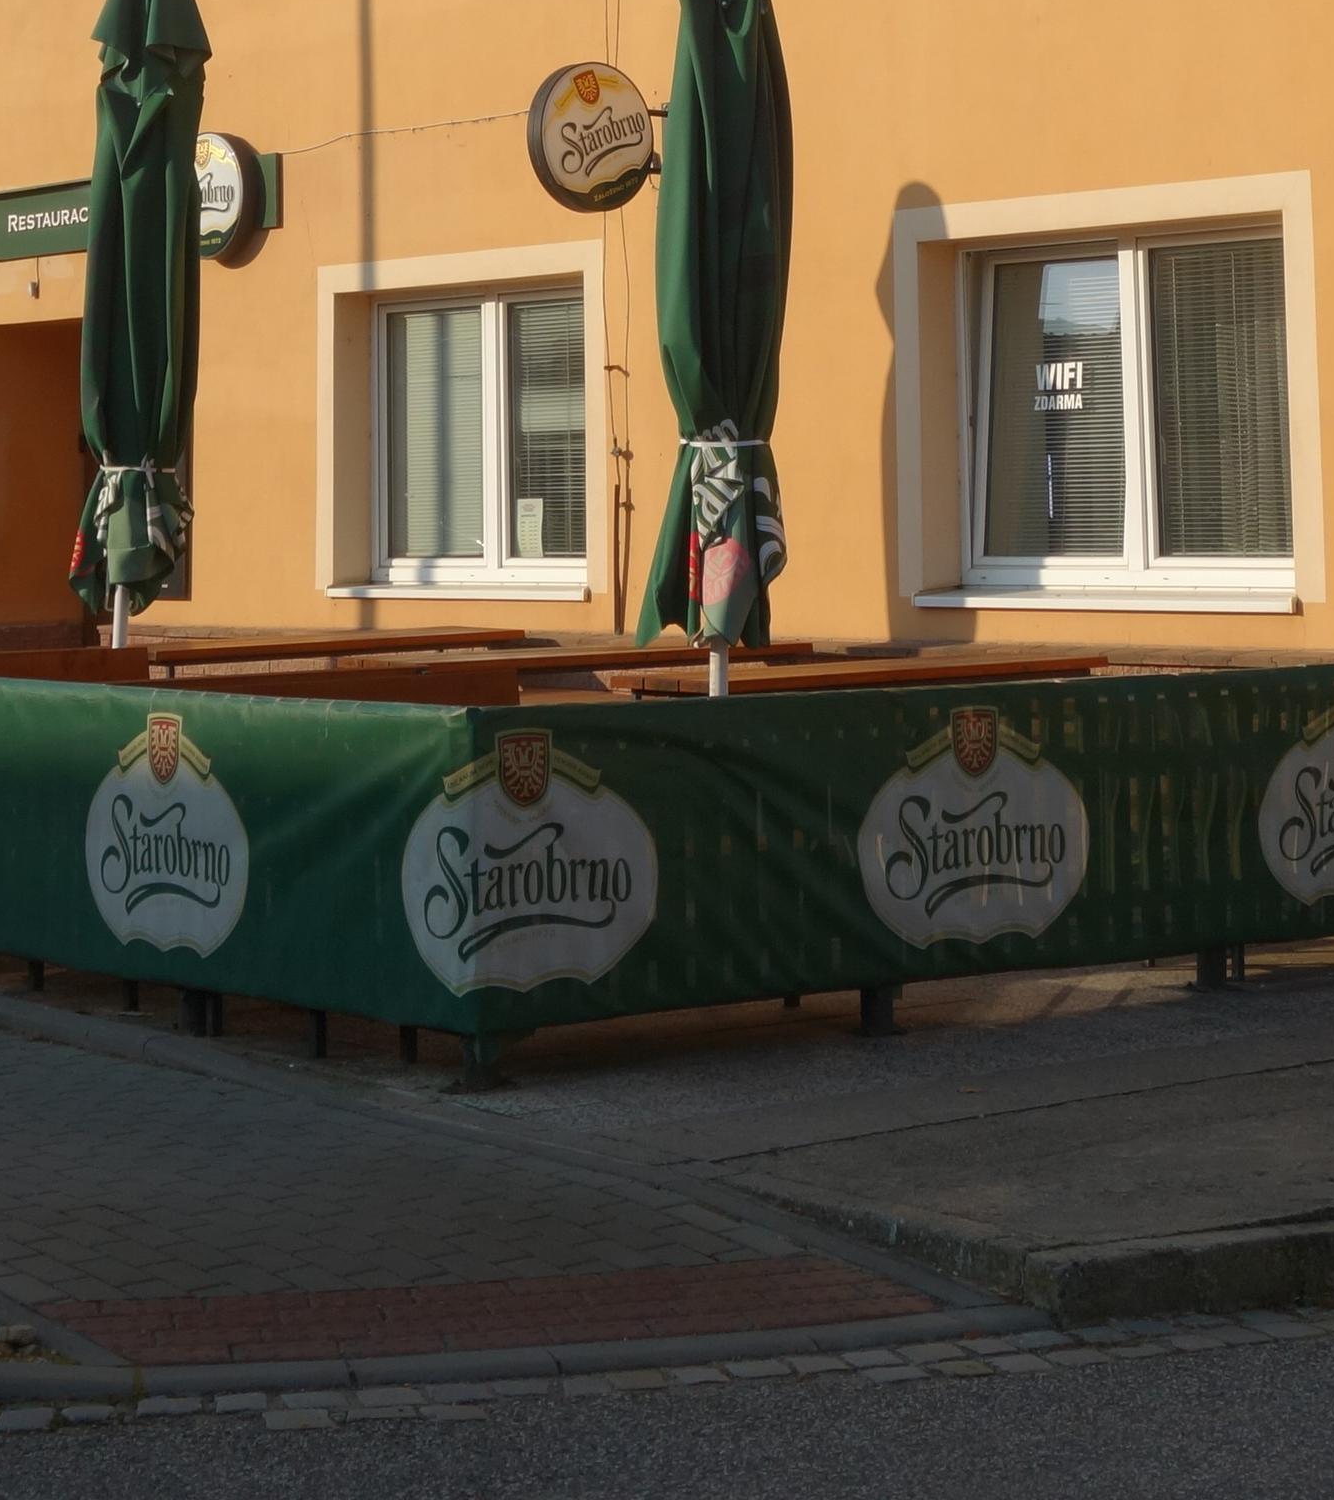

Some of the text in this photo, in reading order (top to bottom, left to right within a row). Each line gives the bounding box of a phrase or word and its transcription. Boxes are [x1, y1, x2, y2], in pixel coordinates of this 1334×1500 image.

[560, 106, 646, 177] Starobrno
[198, 172, 235, 213] obrno
[1034, 394, 1083, 411] ZDARMA
[1035, 361, 1083, 390] WIFI
[100, 793, 230, 916] Starobrno
[885, 791, 1066, 919] Starobrno
[423, 822, 632, 964] Starobrno
